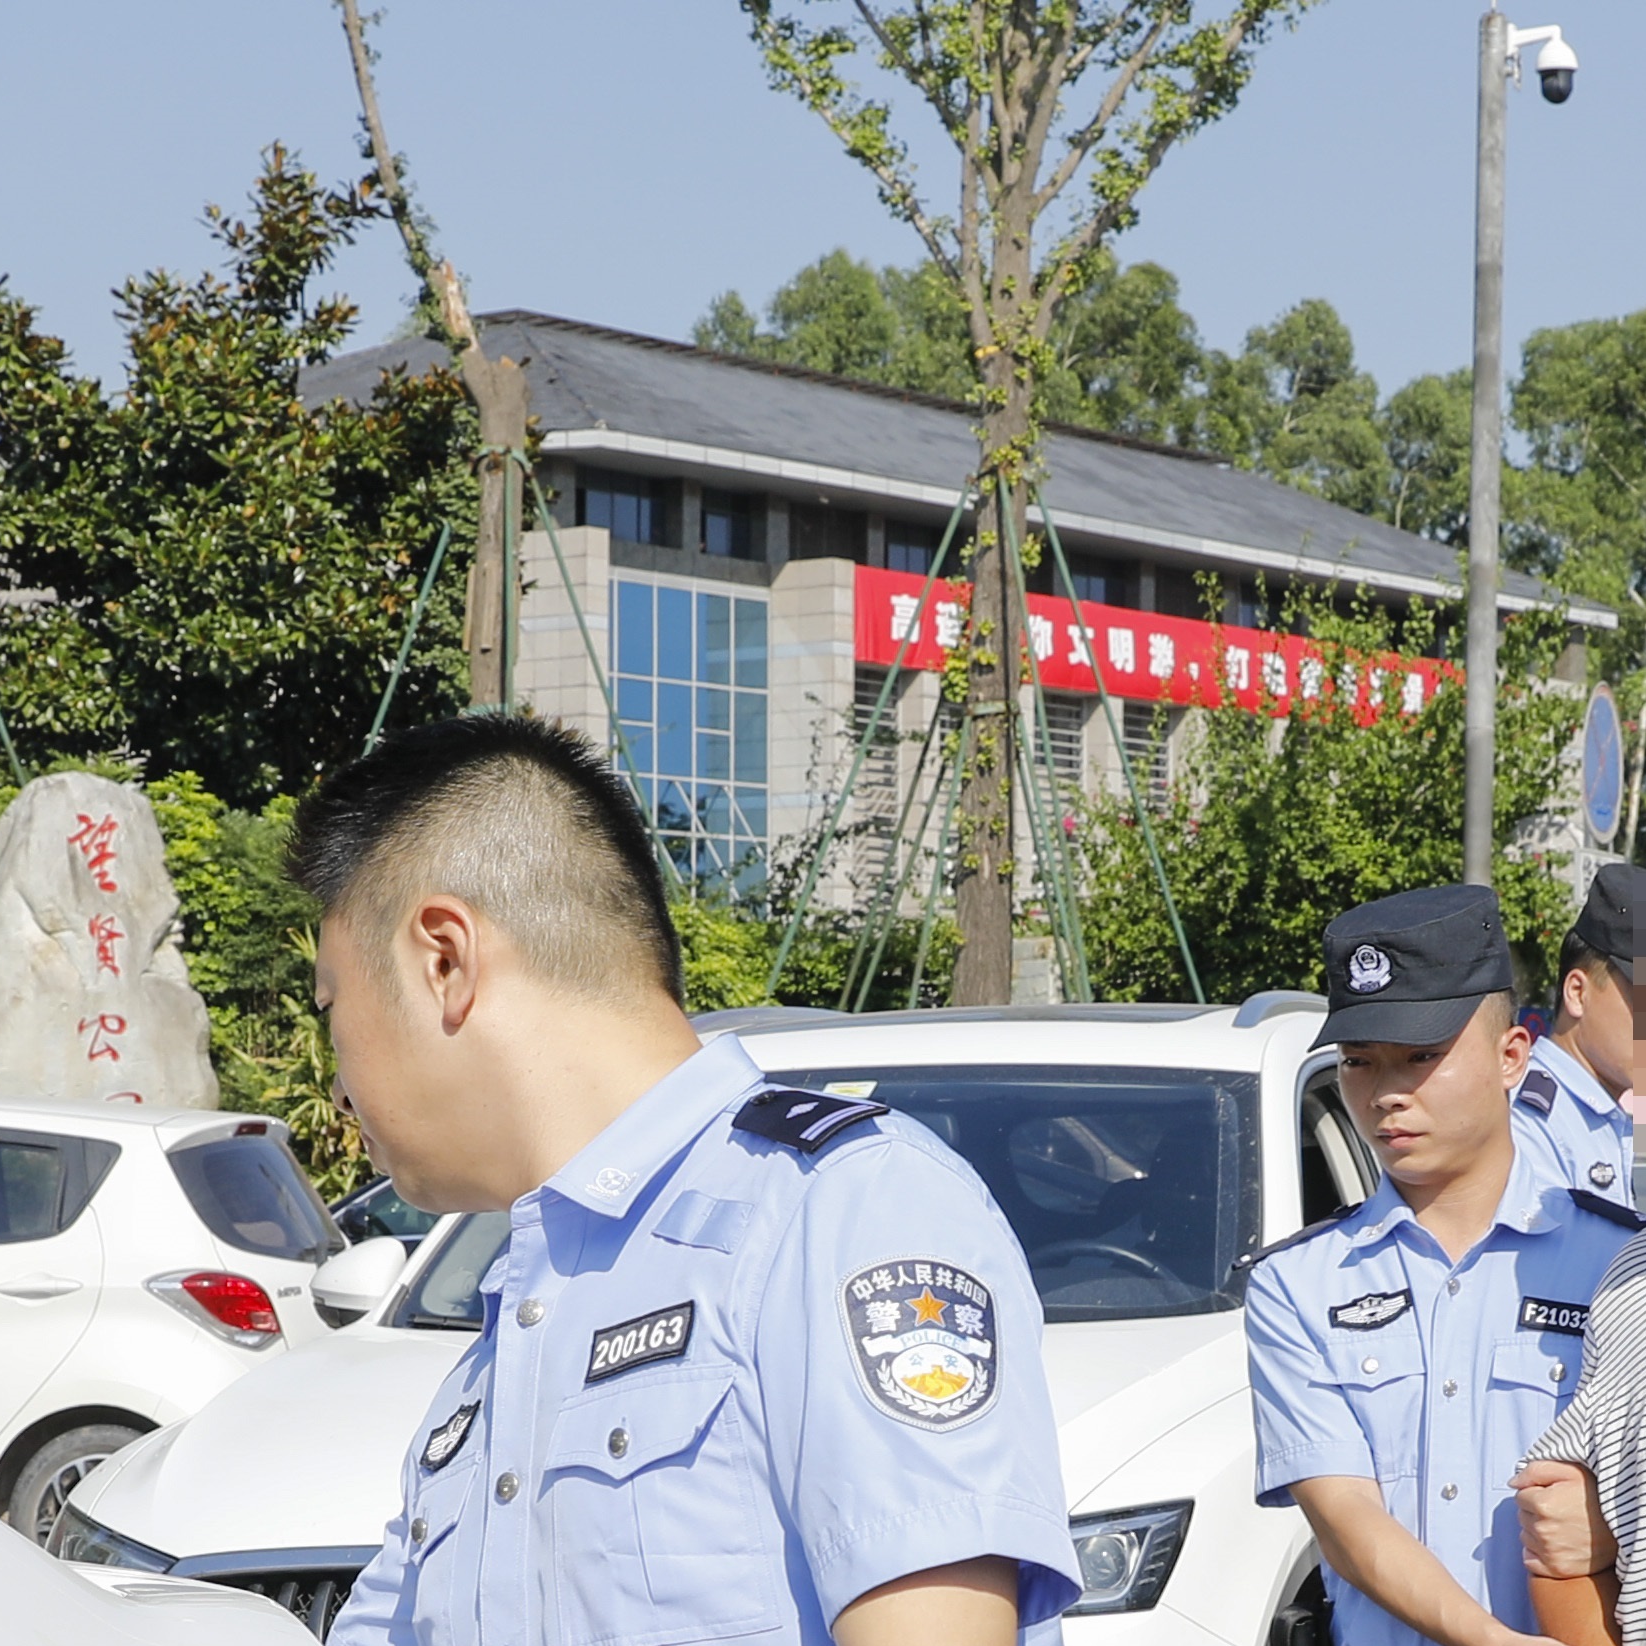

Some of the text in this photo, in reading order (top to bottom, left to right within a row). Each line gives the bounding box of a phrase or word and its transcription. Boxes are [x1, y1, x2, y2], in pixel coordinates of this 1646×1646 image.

[851, 1264, 988, 1309] 中华人民共和国
[592, 1316, 684, 1370] 200163
[900, 1331, 963, 1350] POLICE
